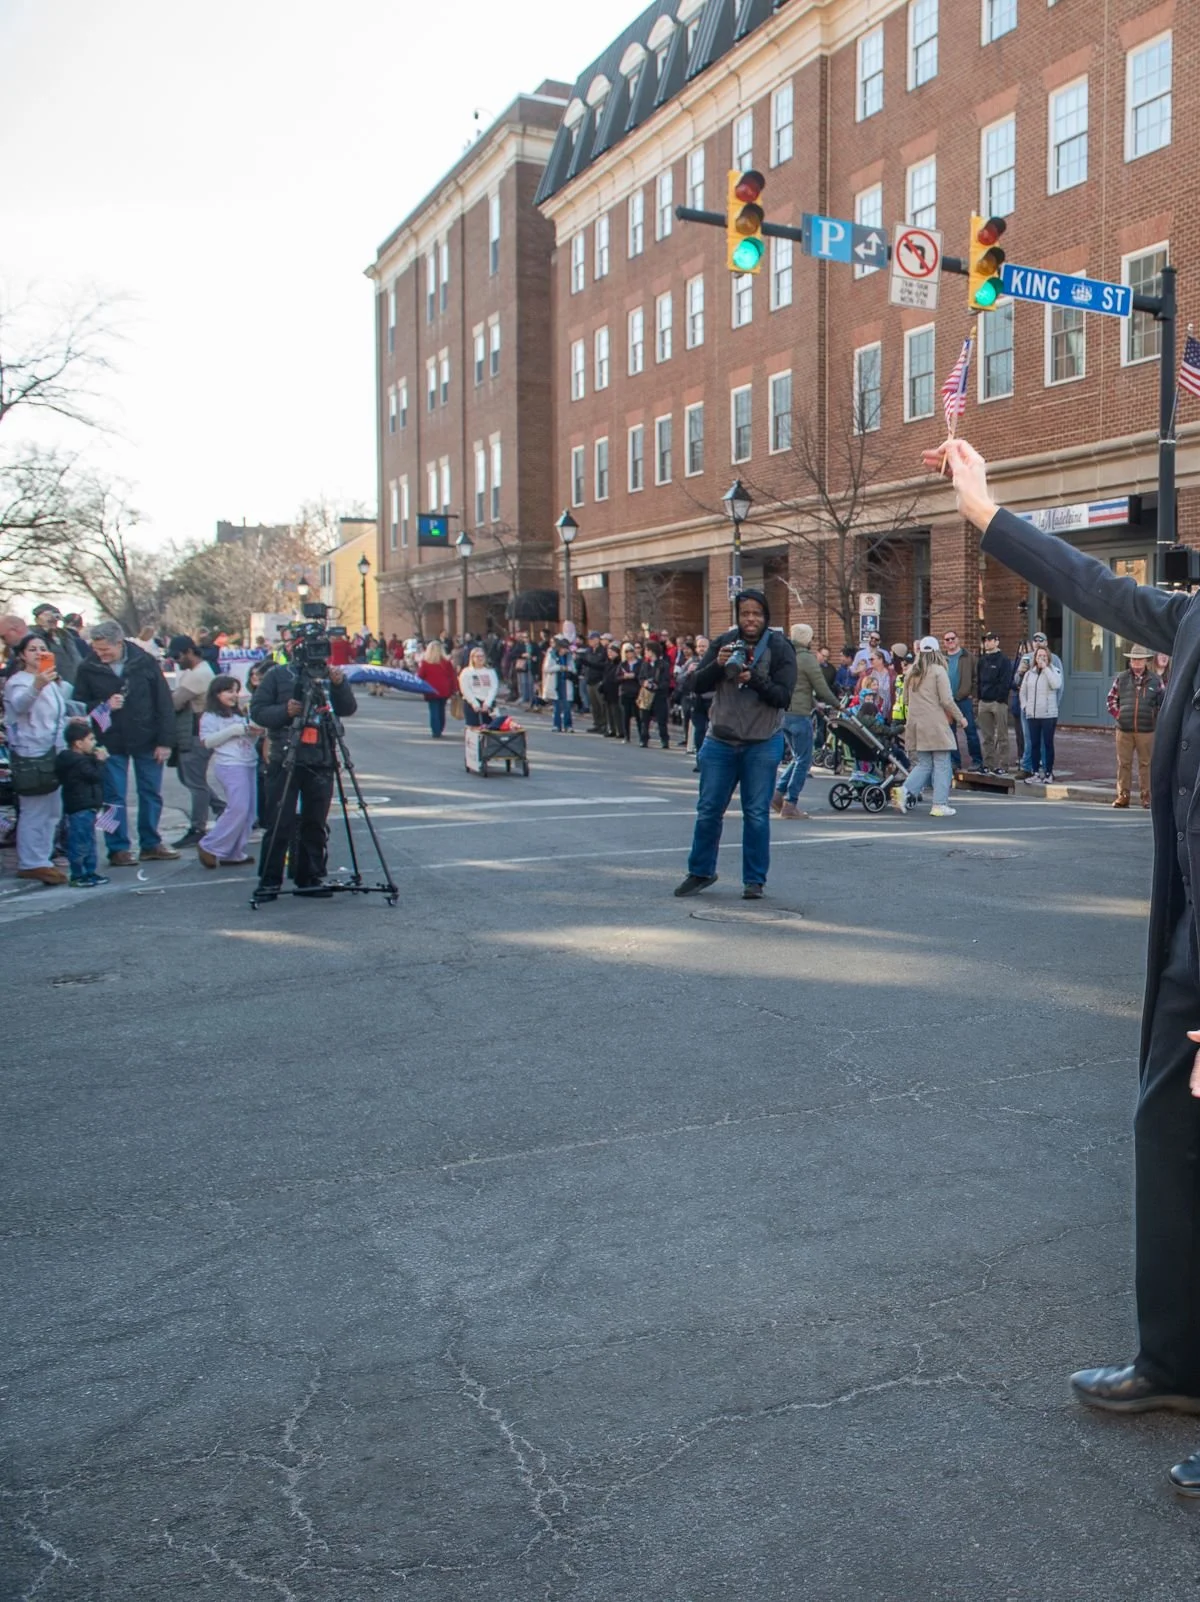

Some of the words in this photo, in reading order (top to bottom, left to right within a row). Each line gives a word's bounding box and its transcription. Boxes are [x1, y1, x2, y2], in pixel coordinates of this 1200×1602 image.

[817, 219, 845, 257] P
[1010, 269, 1061, 301] KING
[1101, 286, 1126, 313] ST
